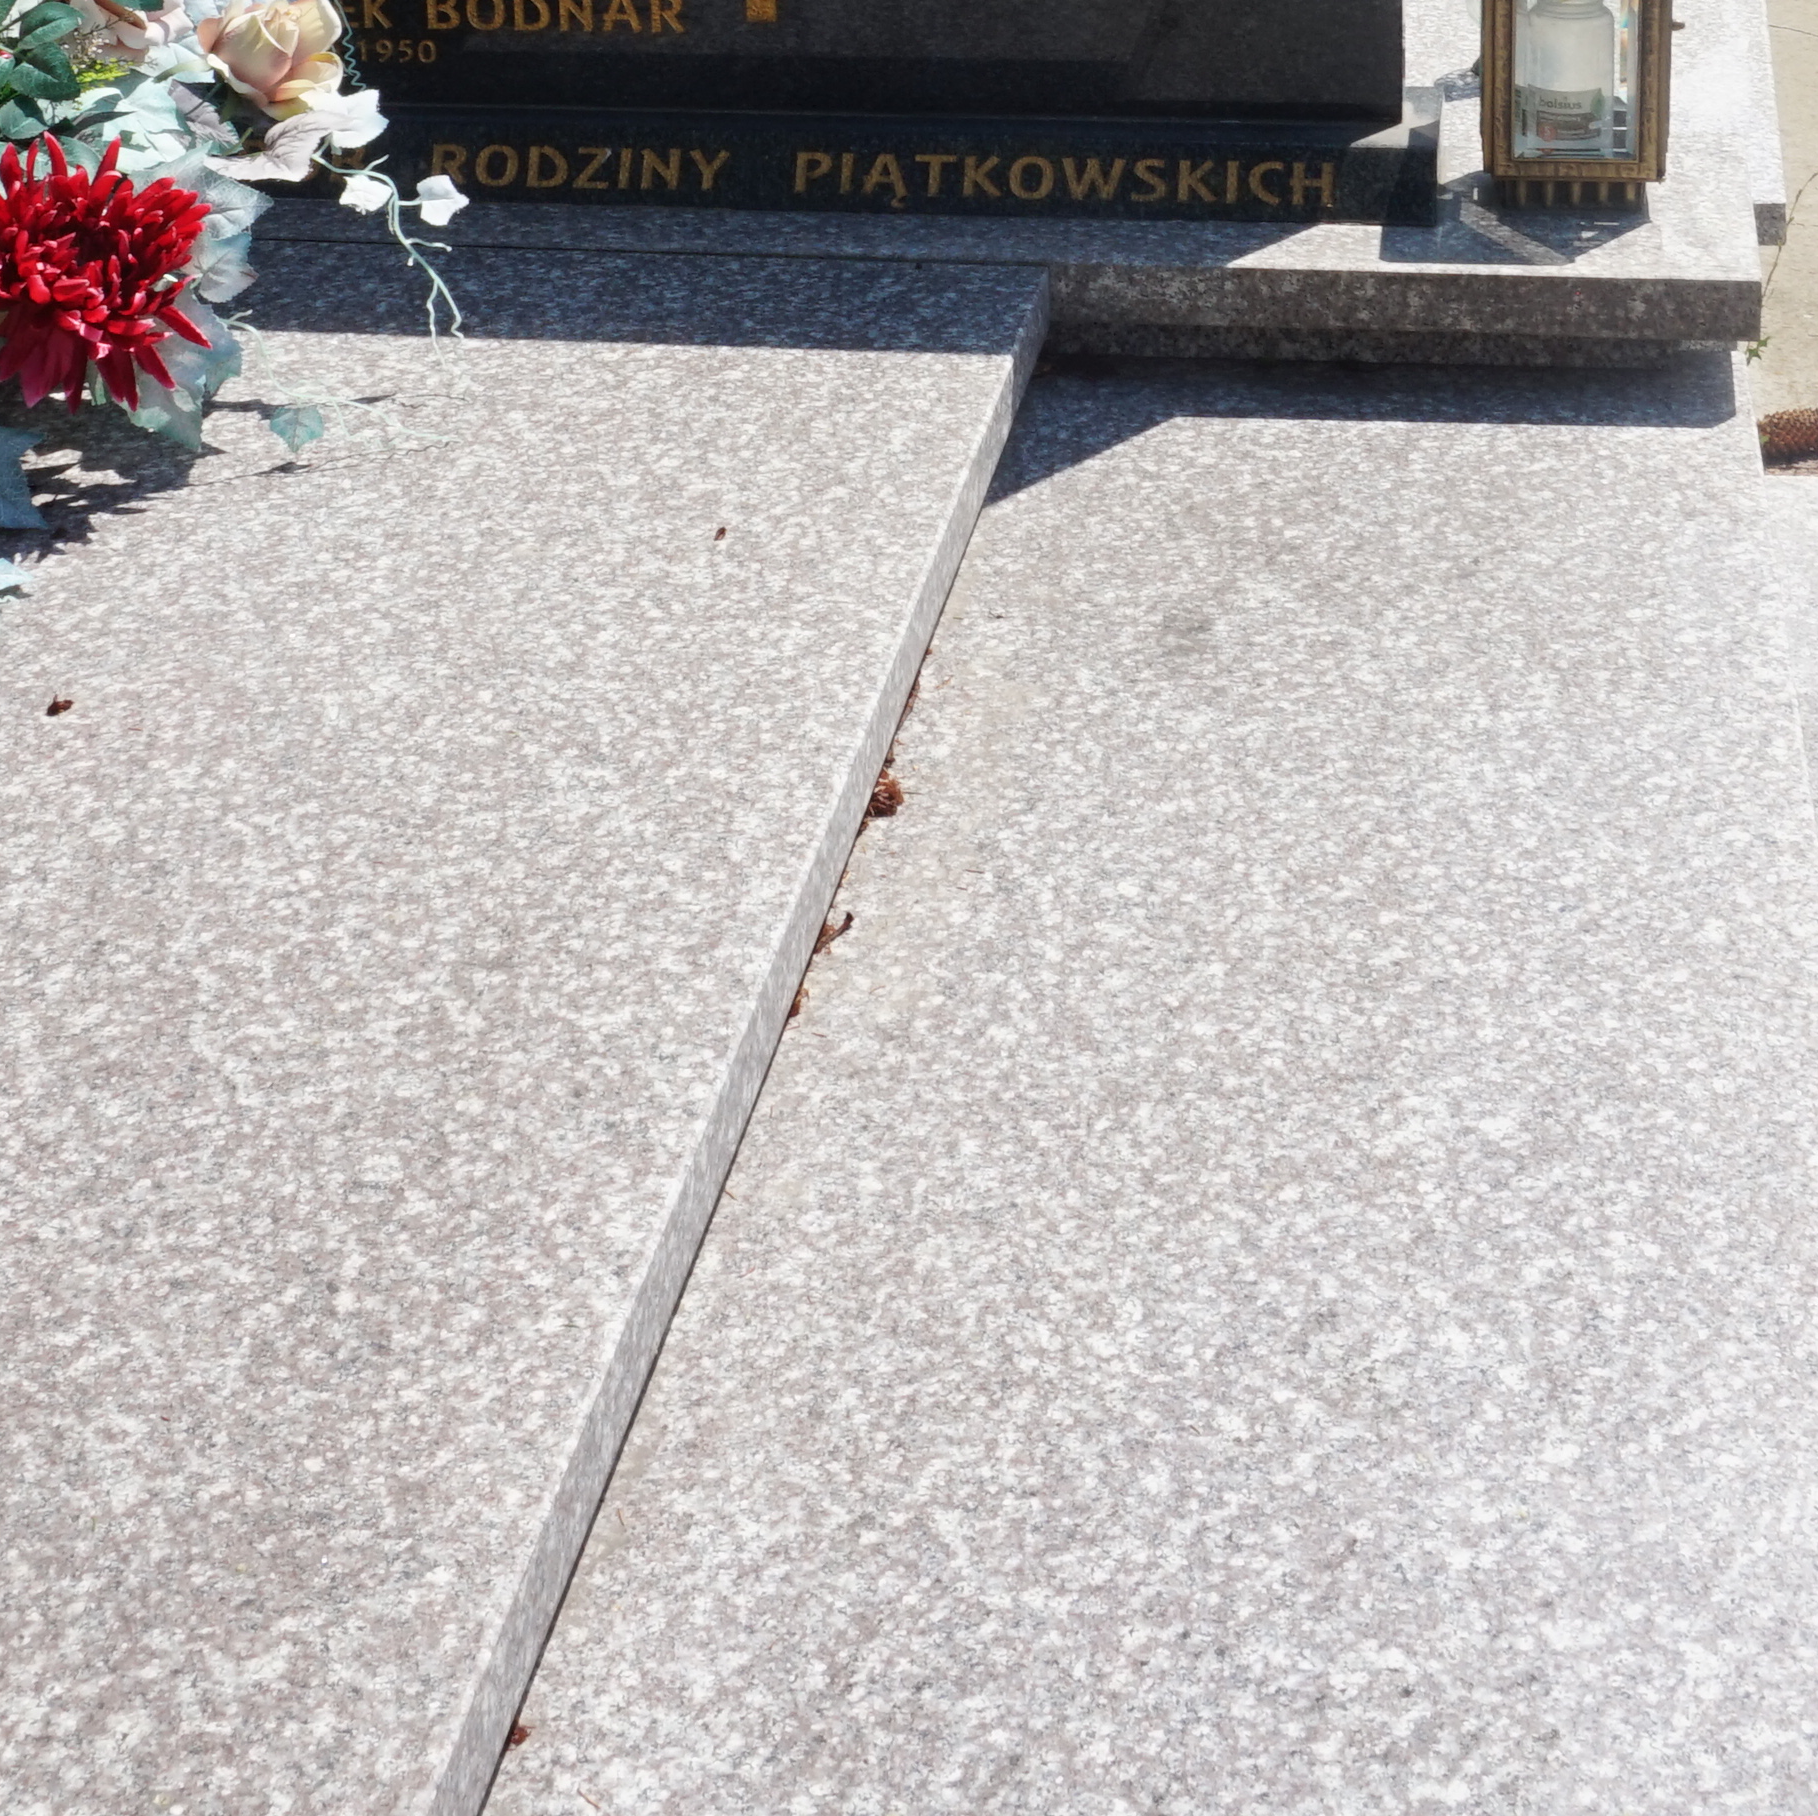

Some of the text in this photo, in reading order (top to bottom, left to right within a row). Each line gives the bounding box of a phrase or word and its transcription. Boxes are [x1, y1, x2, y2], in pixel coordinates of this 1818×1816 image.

[357, 40, 437, 64] 1950
[1538, 95, 1581, 110] bolsius
[431, 141, 731, 191] RODZINY
[793, 149, 1337, 209] PIĄTKOWSKICH
